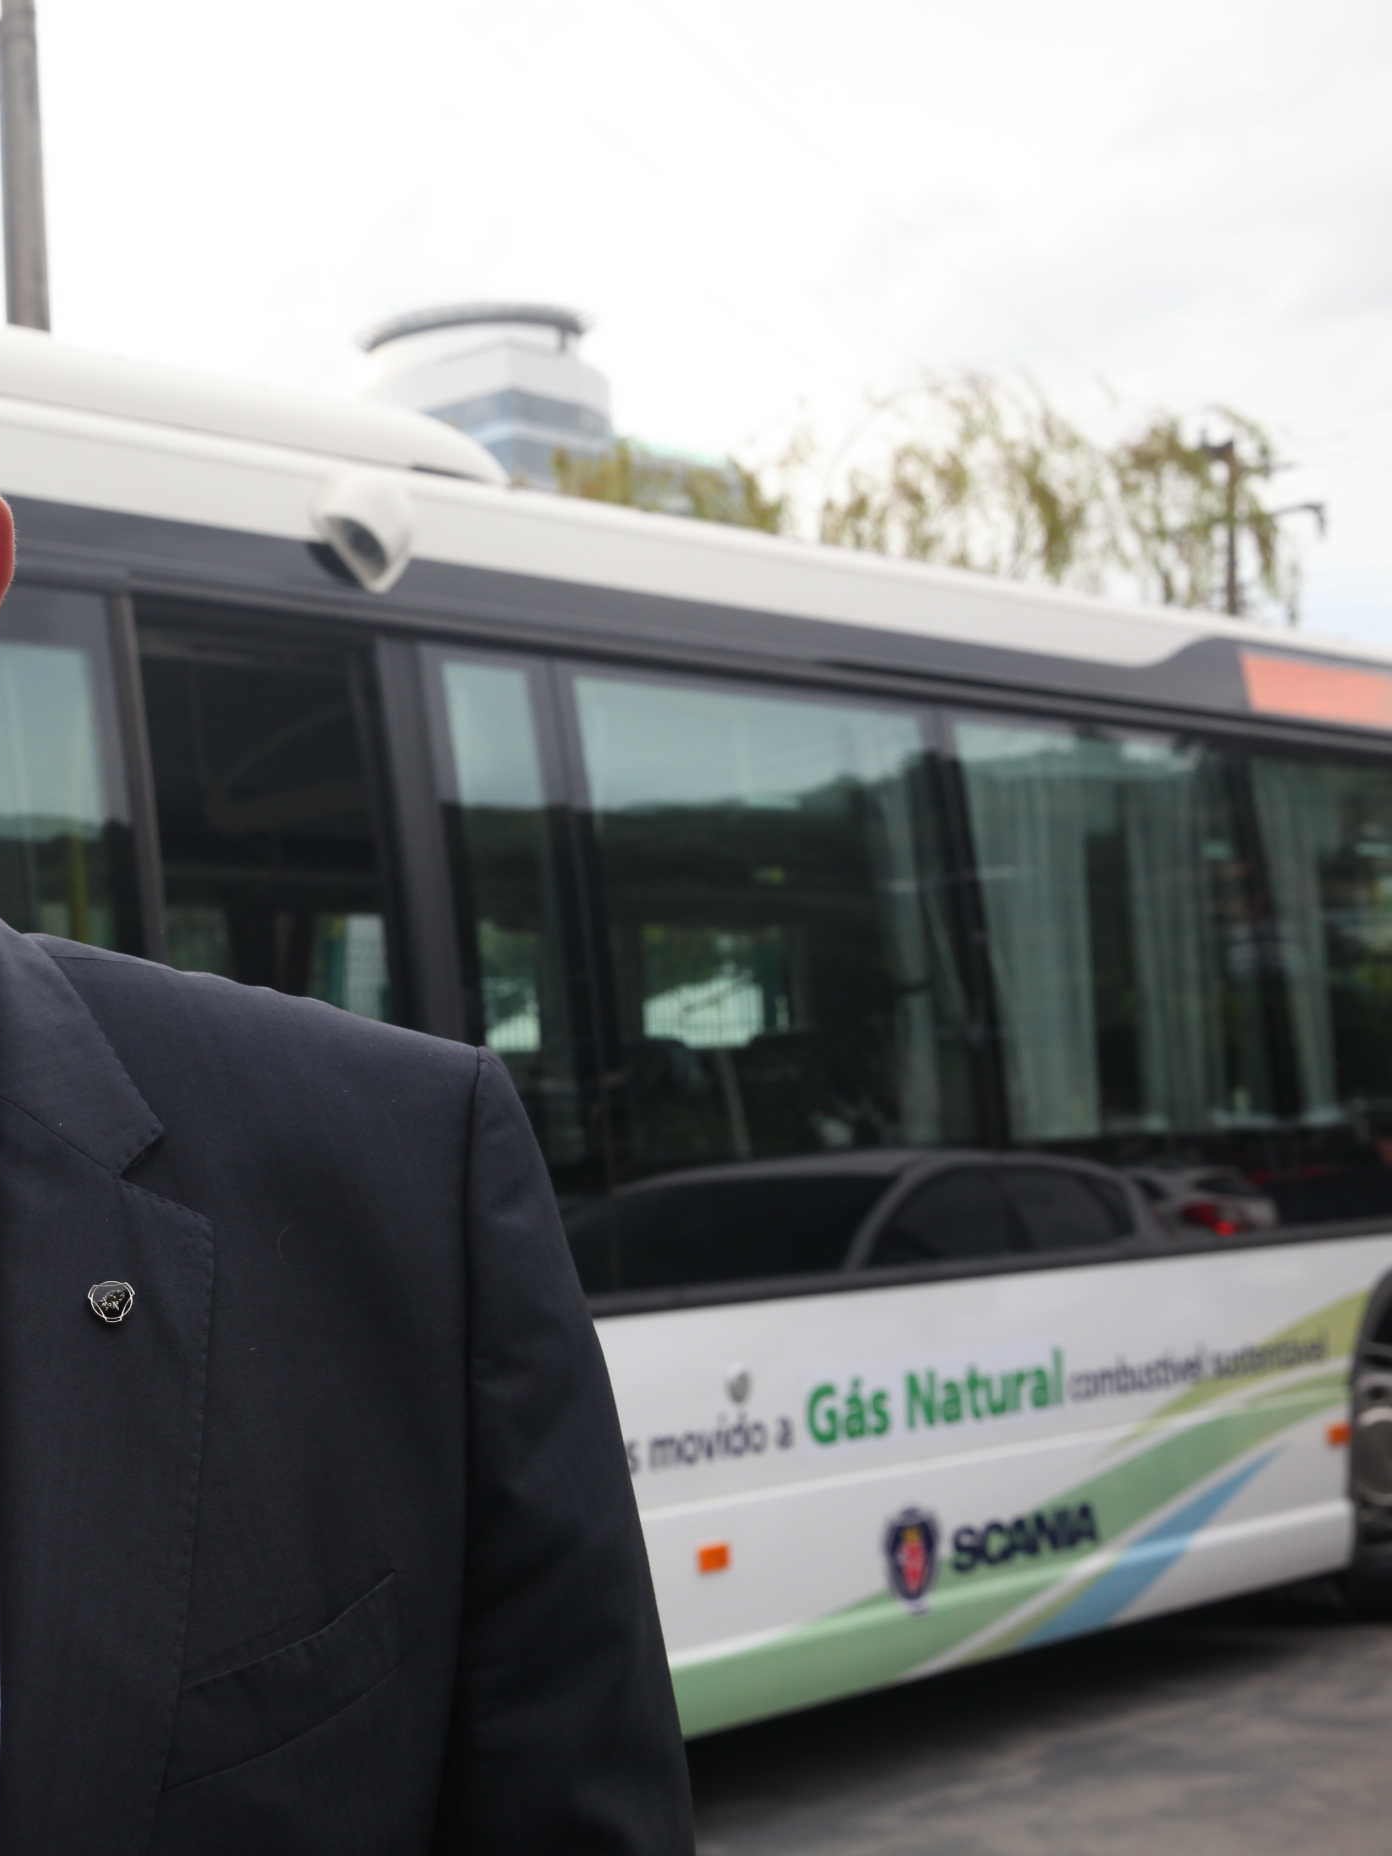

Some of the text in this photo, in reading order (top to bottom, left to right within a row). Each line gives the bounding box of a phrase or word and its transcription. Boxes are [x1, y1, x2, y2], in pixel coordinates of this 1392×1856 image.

[648, 1408, 767, 1471] movido
[777, 1416, 794, 1450] a
[806, 1374, 890, 1445] Gás
[906, 1346, 1064, 1432] Natural
[952, 1502, 1098, 1571] SCANIA
